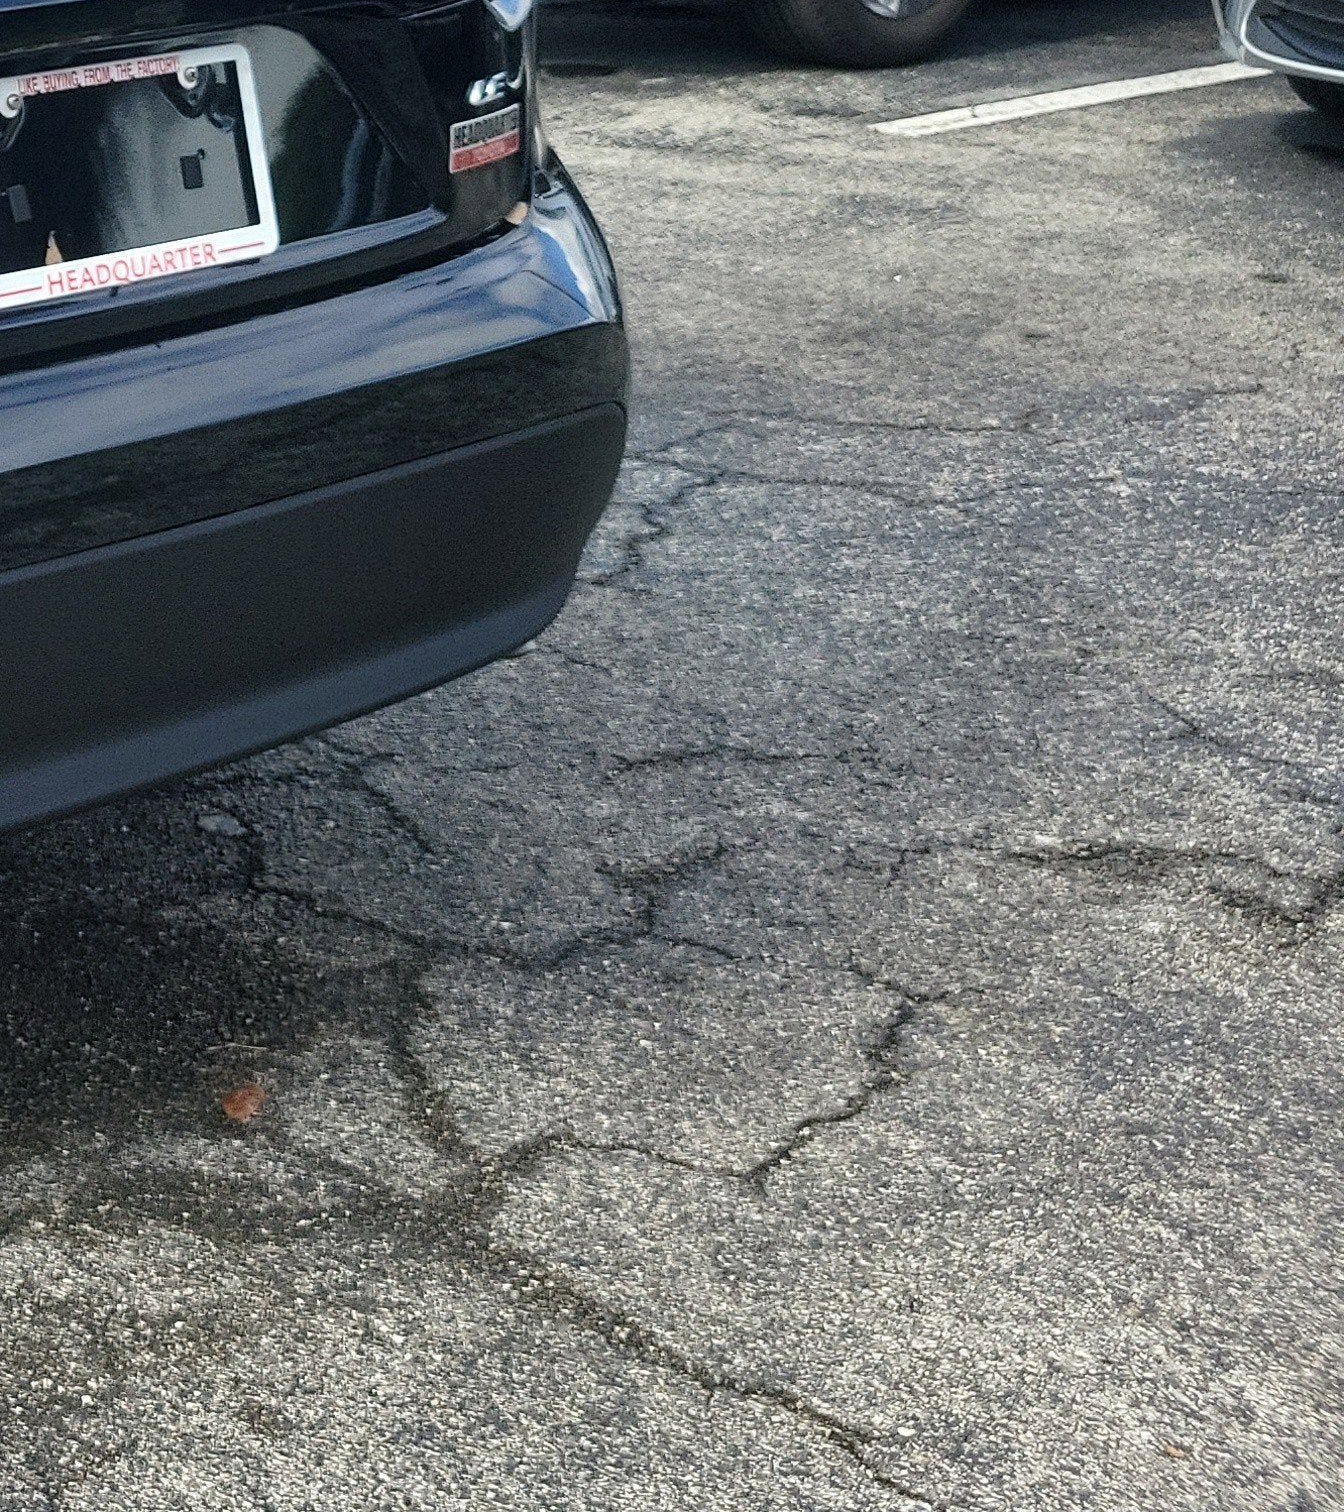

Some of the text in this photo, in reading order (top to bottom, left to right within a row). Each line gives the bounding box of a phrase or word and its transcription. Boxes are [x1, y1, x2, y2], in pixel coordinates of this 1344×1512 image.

[18, 78, 38, 95] LIKE
[44, 71, 79, 93] BUYING
[84, 65, 111, 85] FROM
[115, 62, 133, 80] THE
[46, 242, 217, 295] HEADQUARTER
